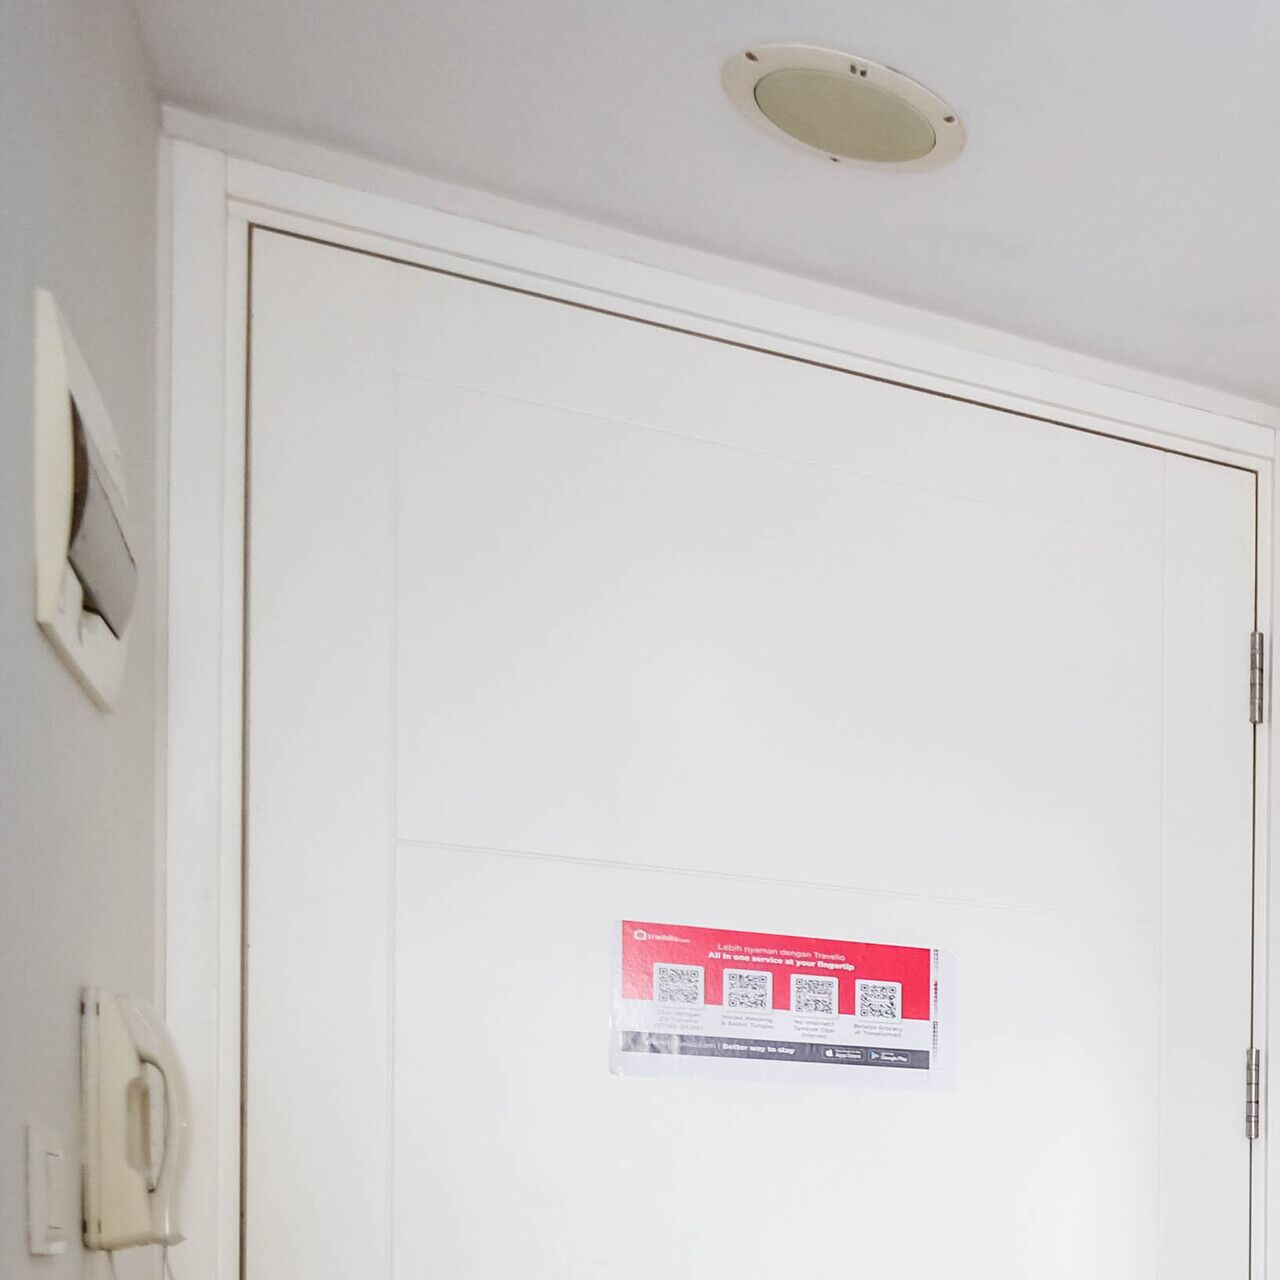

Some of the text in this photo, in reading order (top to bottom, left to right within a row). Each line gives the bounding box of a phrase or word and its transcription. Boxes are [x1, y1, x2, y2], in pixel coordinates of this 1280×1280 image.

[708, 951, 721, 960] All
[752, 955, 783, 965] service
[785, 957, 794, 965] at
[795, 959, 816, 969] your
[817, 961, 855, 971] fingertip
[723, 1042, 749, 1051] Better
[750, 1046, 766, 1054] way
[767, 1045, 777, 1053] to
[778, 1046, 796, 1055] stay
